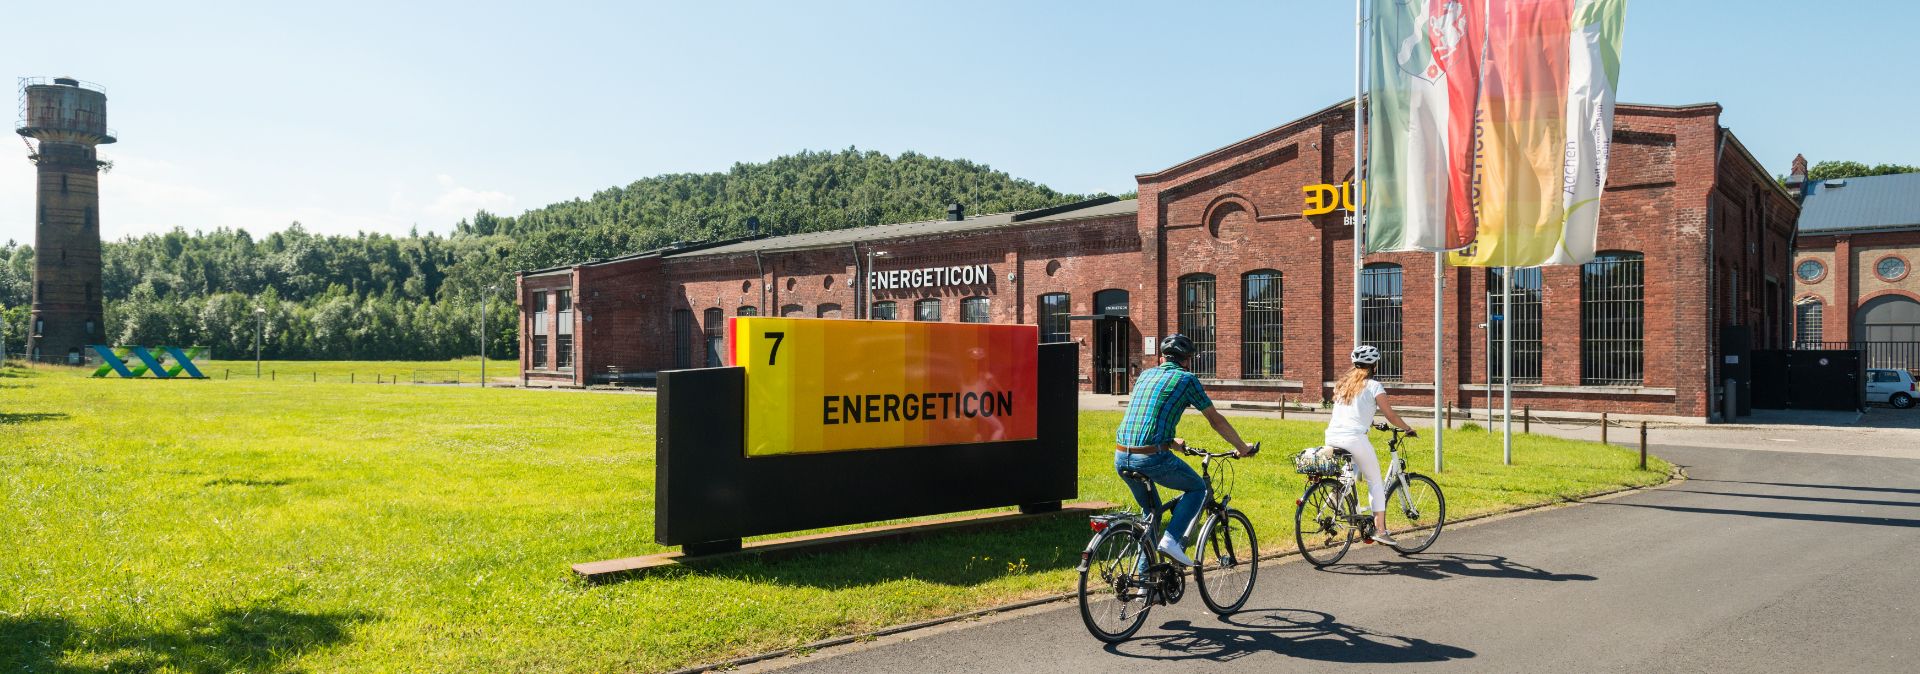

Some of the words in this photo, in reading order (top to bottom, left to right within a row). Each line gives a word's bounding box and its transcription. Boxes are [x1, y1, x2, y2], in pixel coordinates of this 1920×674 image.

[1563, 141, 1575, 195] Aachen
[868, 264, 988, 290] ENERGETICON
[764, 332, 784, 365] 7
[823, 391, 1012, 425] ENERGETICON
